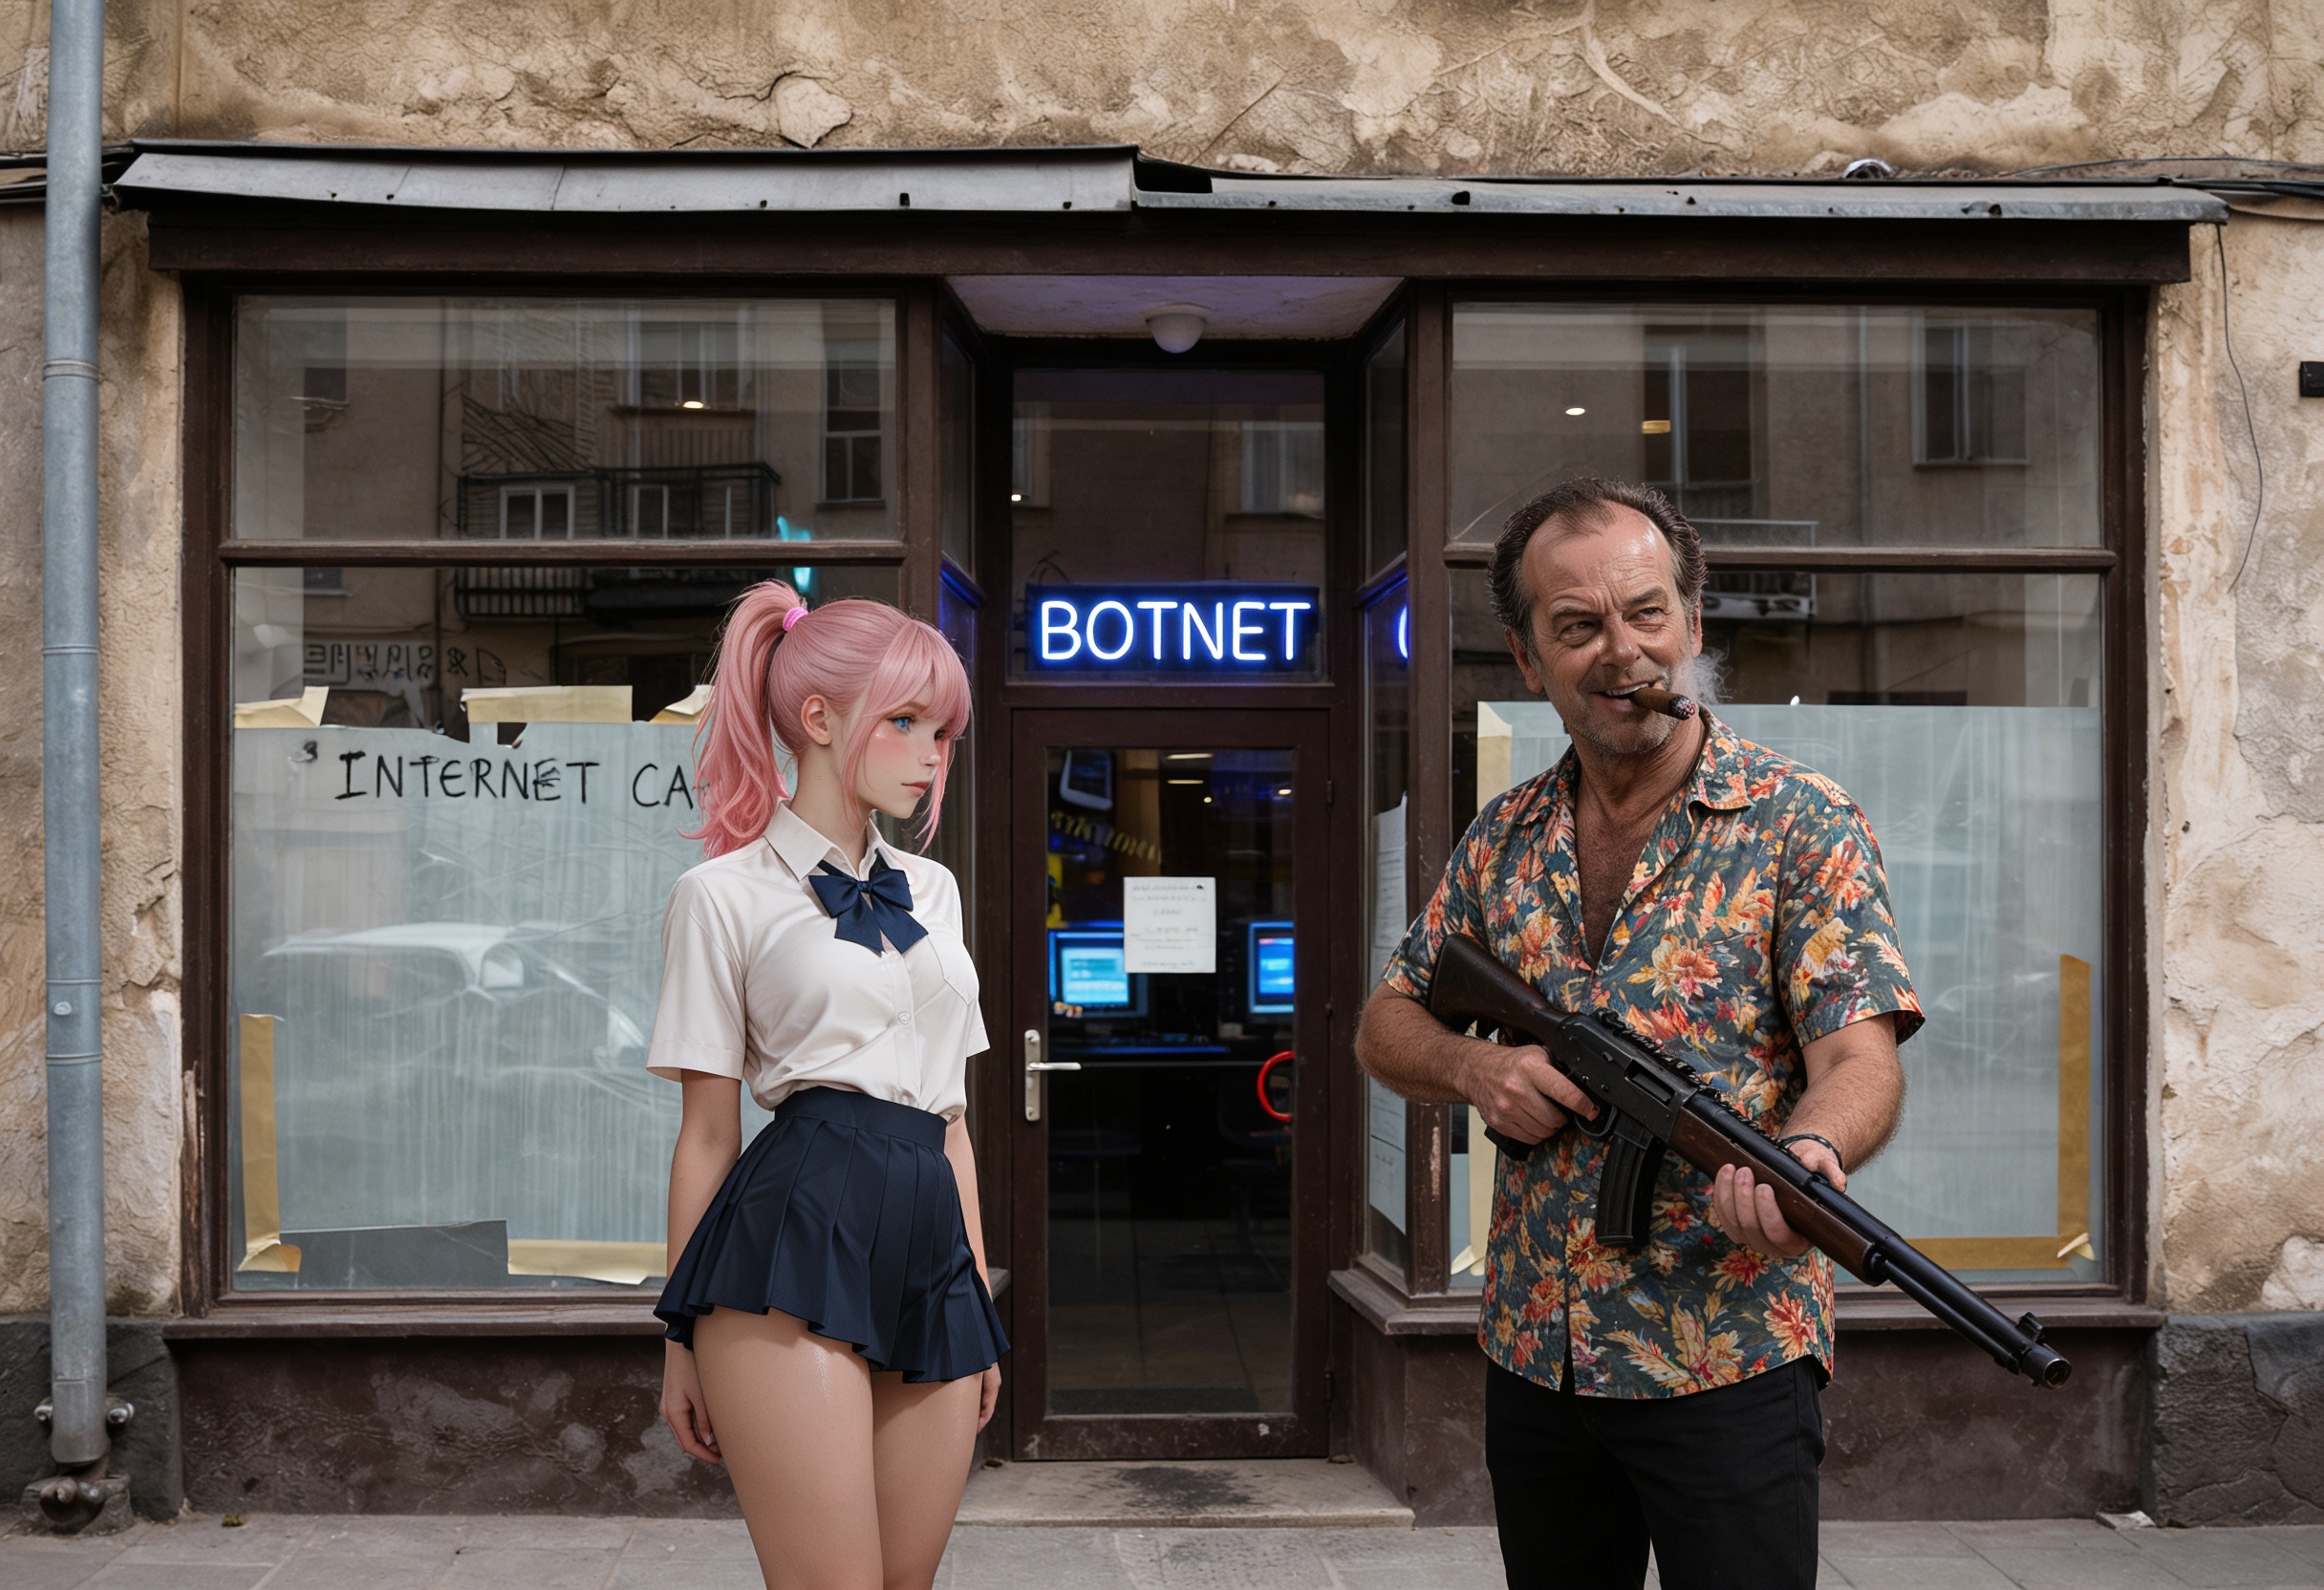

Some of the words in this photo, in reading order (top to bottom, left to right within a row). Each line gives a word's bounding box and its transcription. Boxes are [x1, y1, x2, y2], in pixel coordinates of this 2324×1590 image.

[1040, 599, 1312, 661] BOTNET
[334, 750, 600, 805] INTERNET
[632, 763, 711, 810] CA
